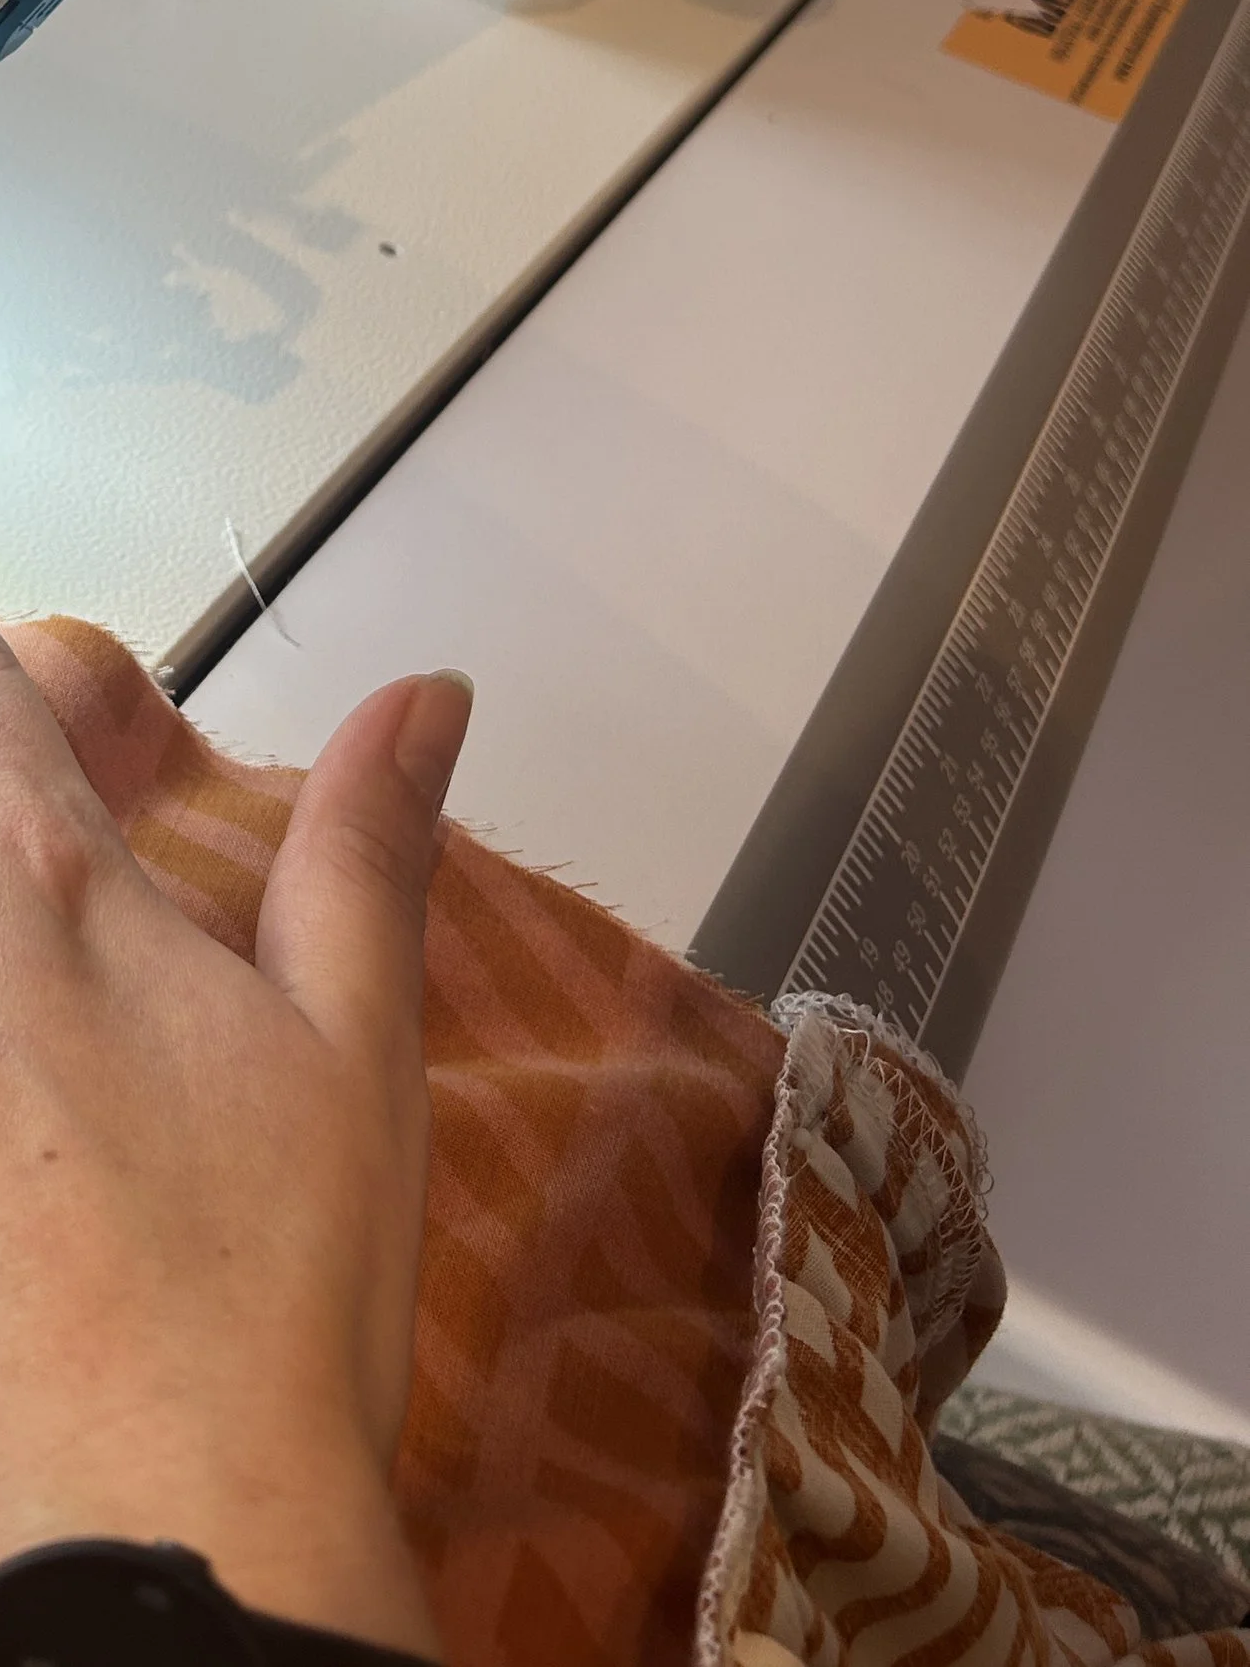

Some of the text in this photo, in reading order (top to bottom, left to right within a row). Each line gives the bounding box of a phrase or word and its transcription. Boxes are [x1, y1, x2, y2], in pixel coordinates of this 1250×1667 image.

[901, 840, 920, 875] 20
[907, 900, 926, 936] 50
[859, 937, 879, 971] 19
[892, 939, 911, 972] 49
